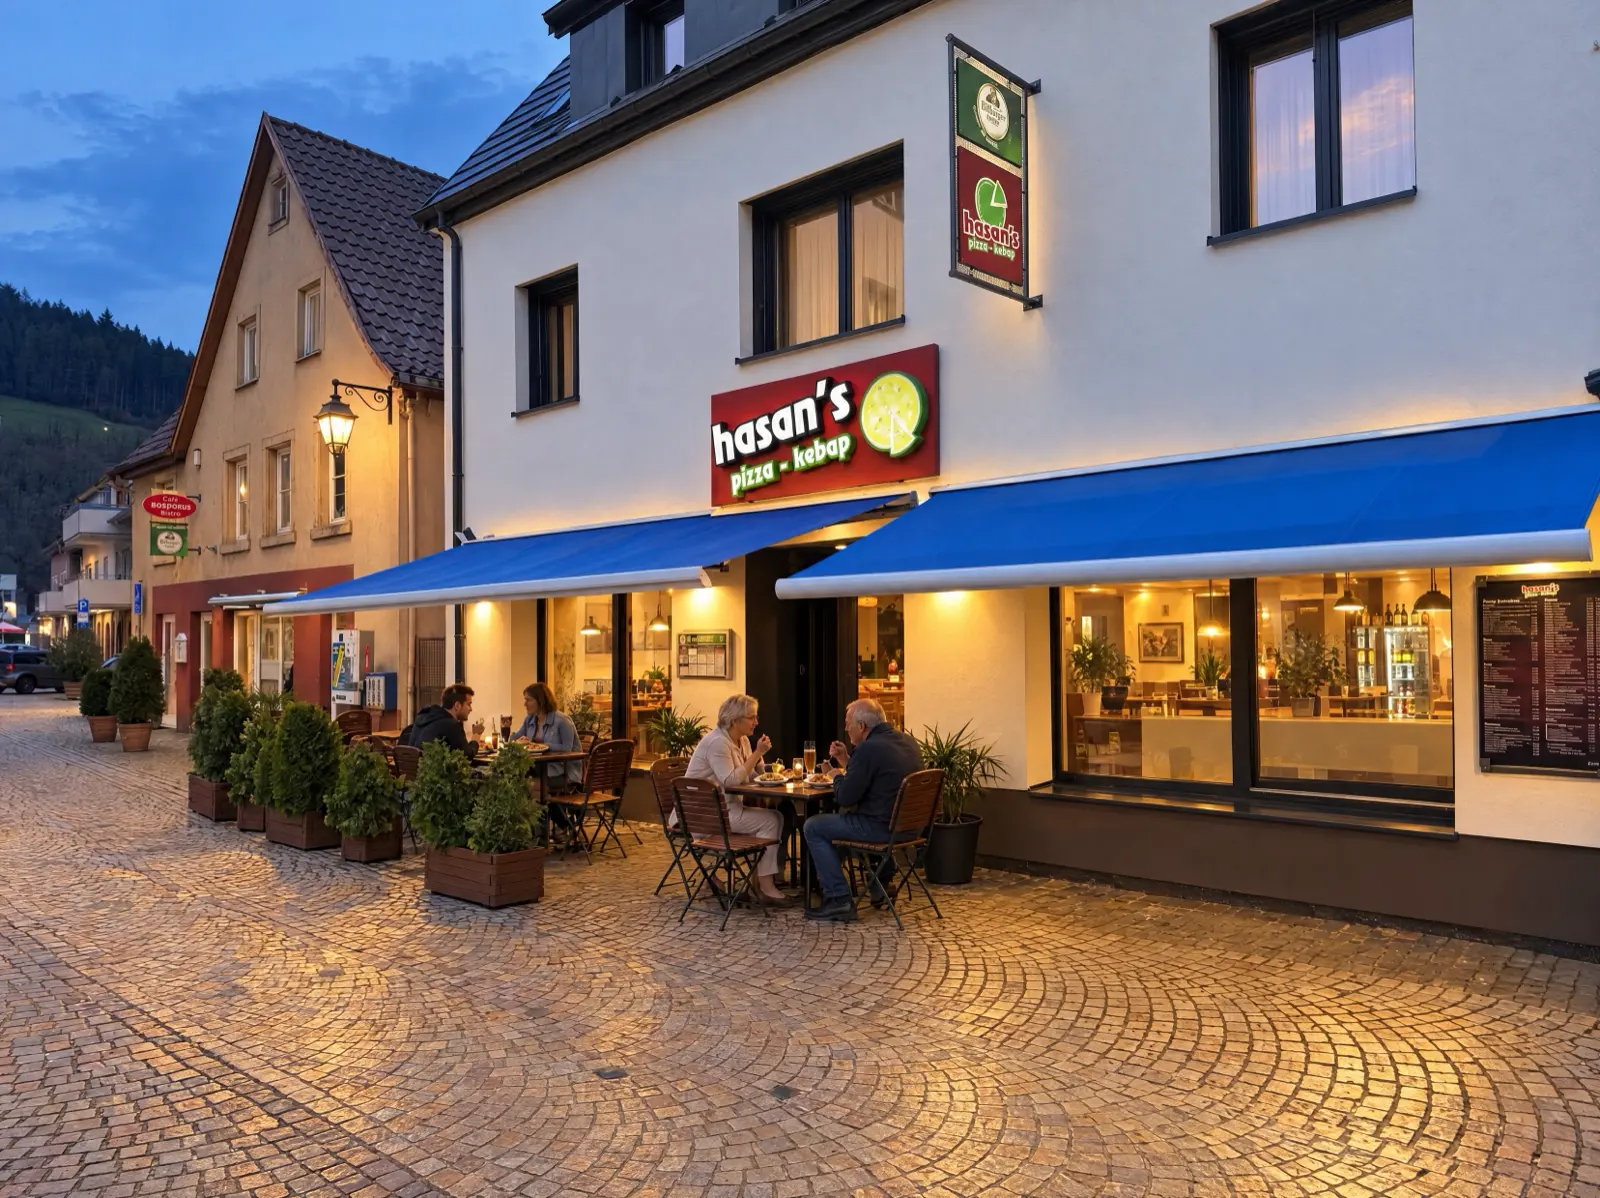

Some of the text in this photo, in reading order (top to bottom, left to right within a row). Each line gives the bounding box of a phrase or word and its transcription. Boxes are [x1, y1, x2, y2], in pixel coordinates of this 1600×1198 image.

[963, 209, 1020, 249] hasan's
[968, 237, 988, 252] pizza
[993, 243, 1016, 261] kebap
[712, 377, 853, 466] hasan's
[730, 459, 779, 497] pizza
[792, 432, 855, 472] kebap
[80, 601, 87, 610] P
